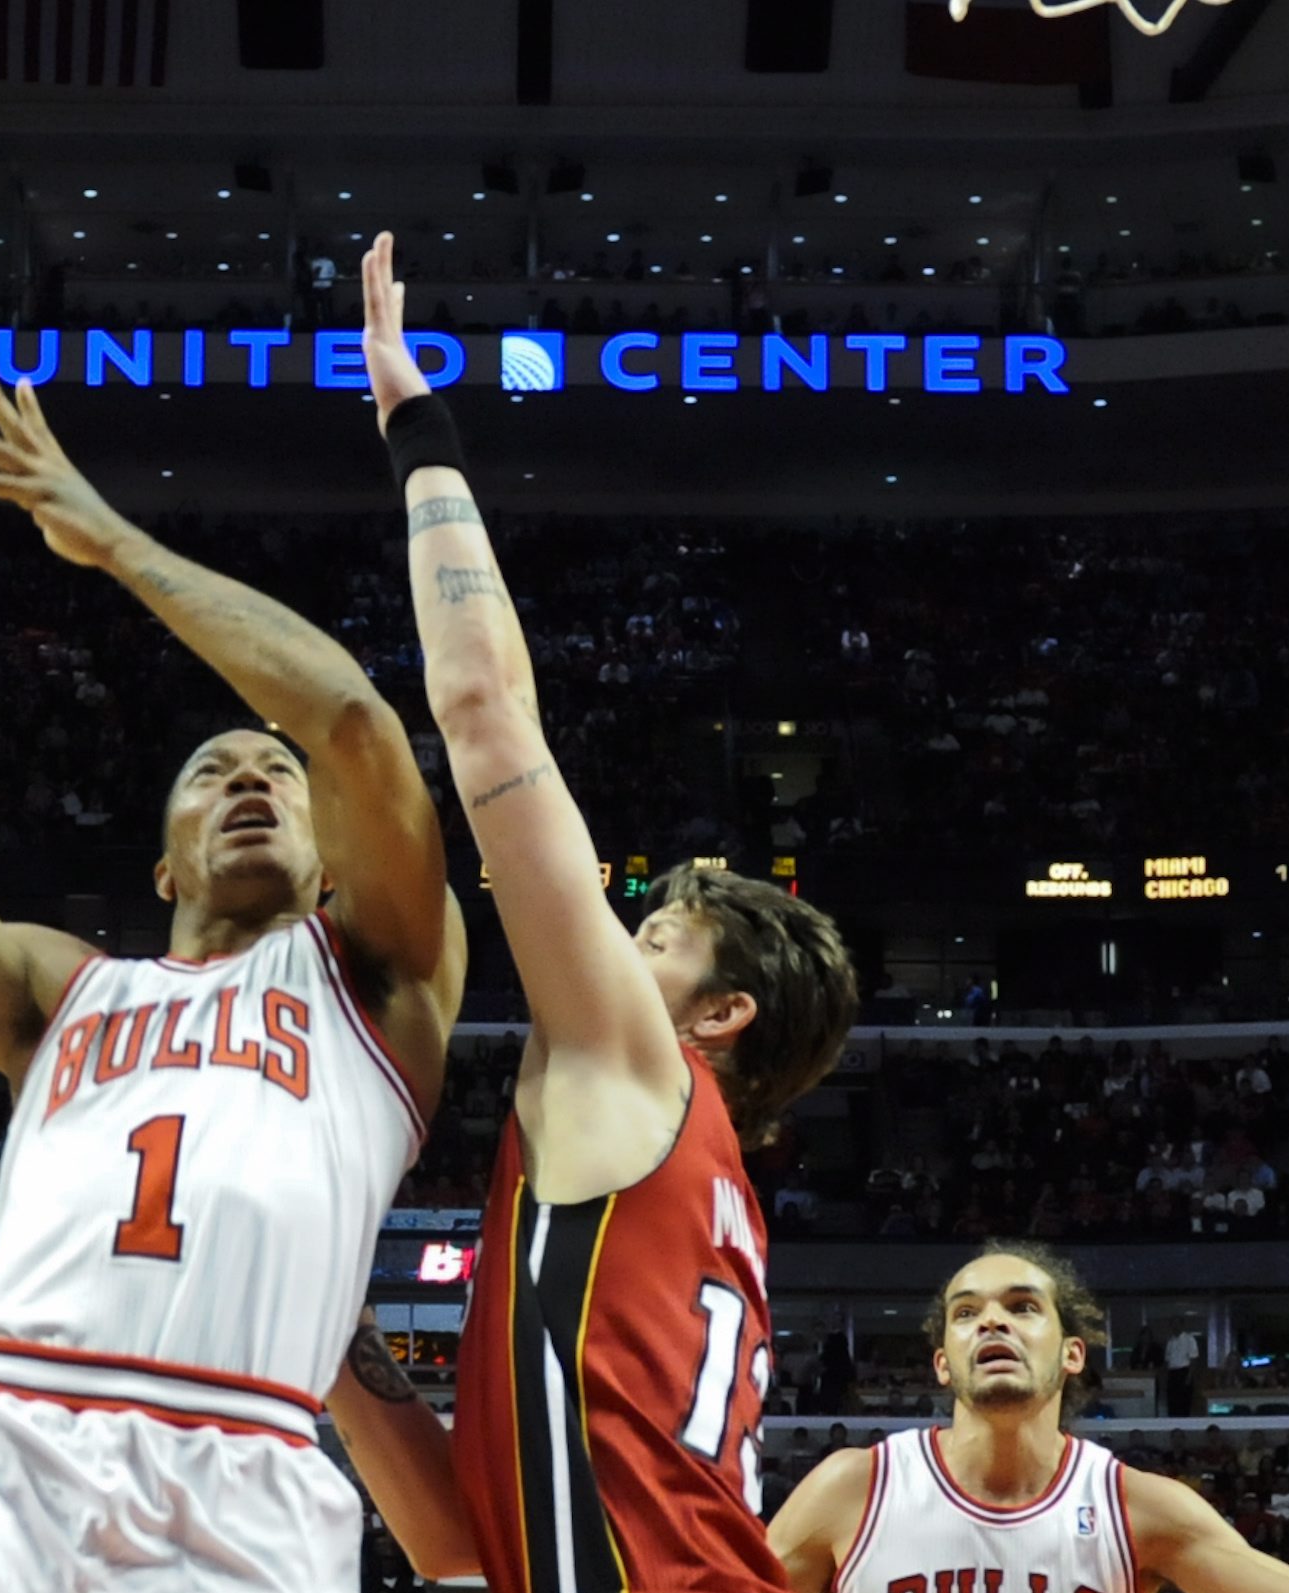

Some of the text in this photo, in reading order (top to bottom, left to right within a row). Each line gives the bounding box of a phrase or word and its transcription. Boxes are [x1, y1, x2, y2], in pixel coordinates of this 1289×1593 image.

[601, 333, 1068, 393] CENTER
[1143, 856, 1207, 877] MIAMI
[1143, 877, 1230, 899] CHICAGO
[41, 985, 310, 1126] BULLS
[112, 1113, 186, 1262] 1
